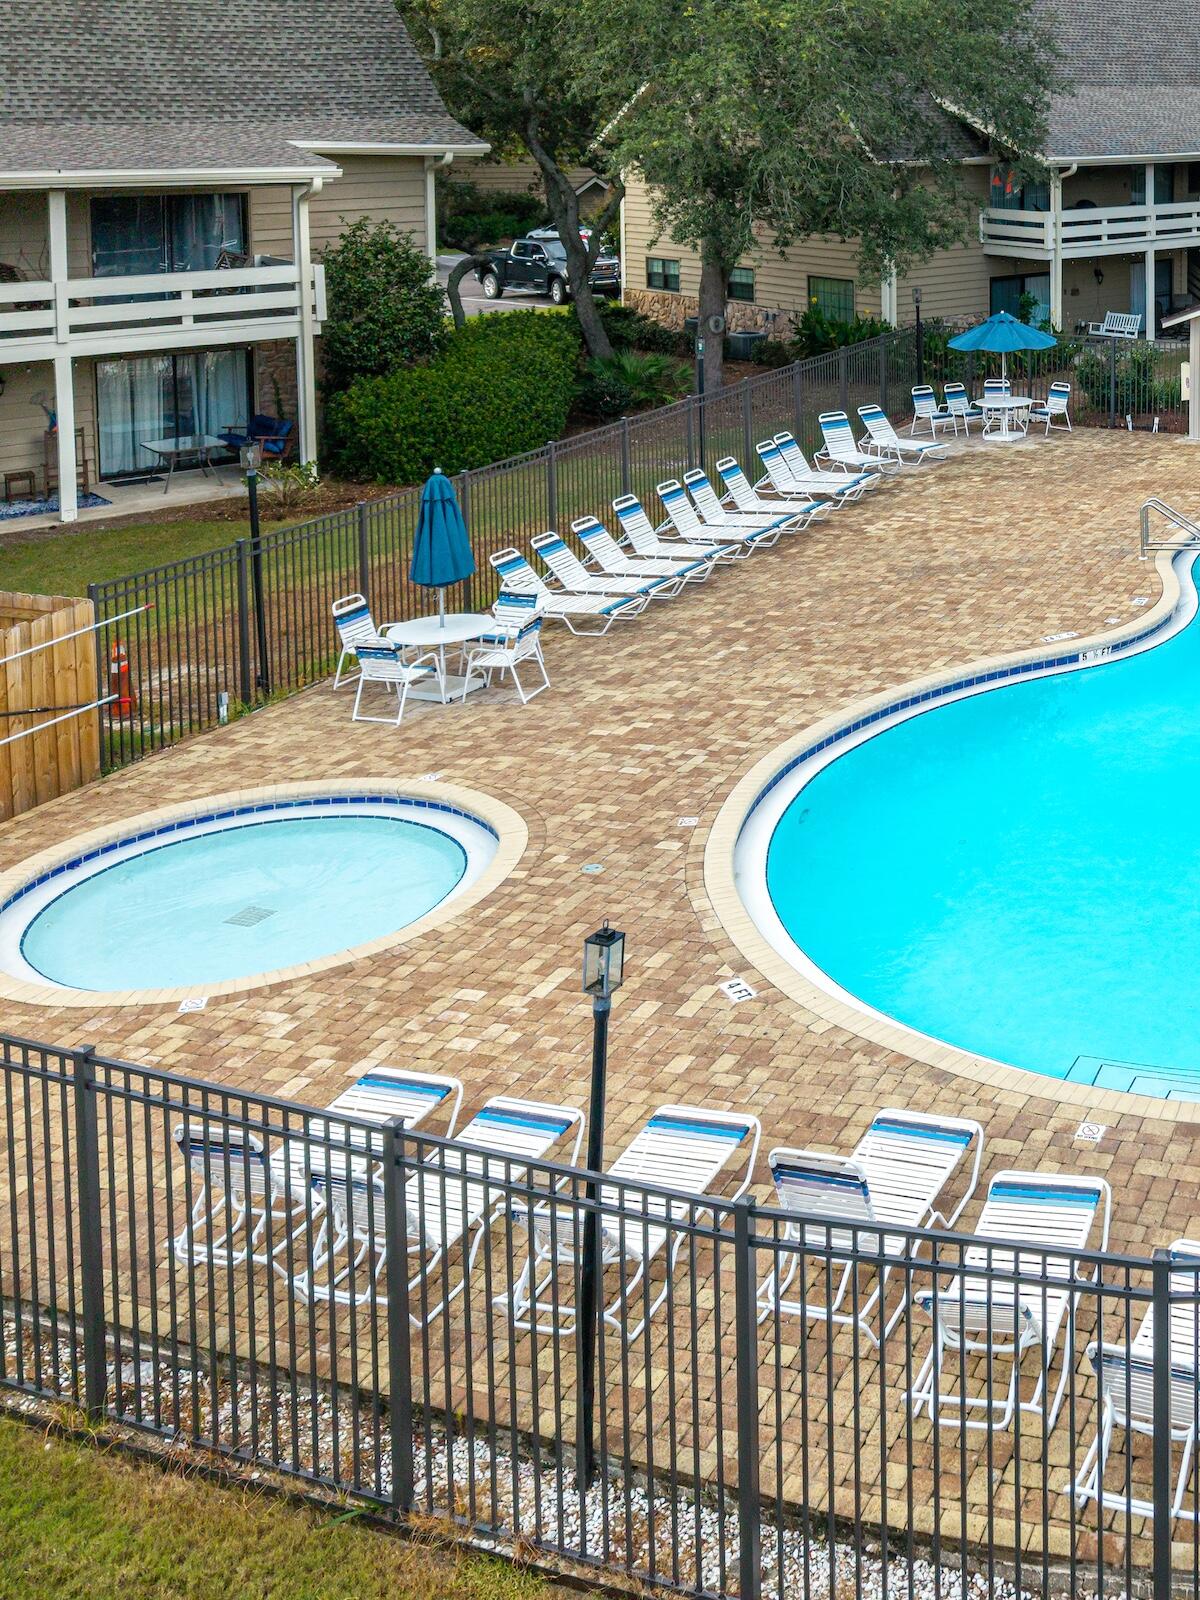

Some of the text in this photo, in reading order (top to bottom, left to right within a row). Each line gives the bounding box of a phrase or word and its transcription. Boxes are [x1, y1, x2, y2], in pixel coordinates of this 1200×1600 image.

[1082, 652, 1087, 661] 5
[1101, 646, 1111, 656] FT
[727, 982, 753, 1001] 4 FT
